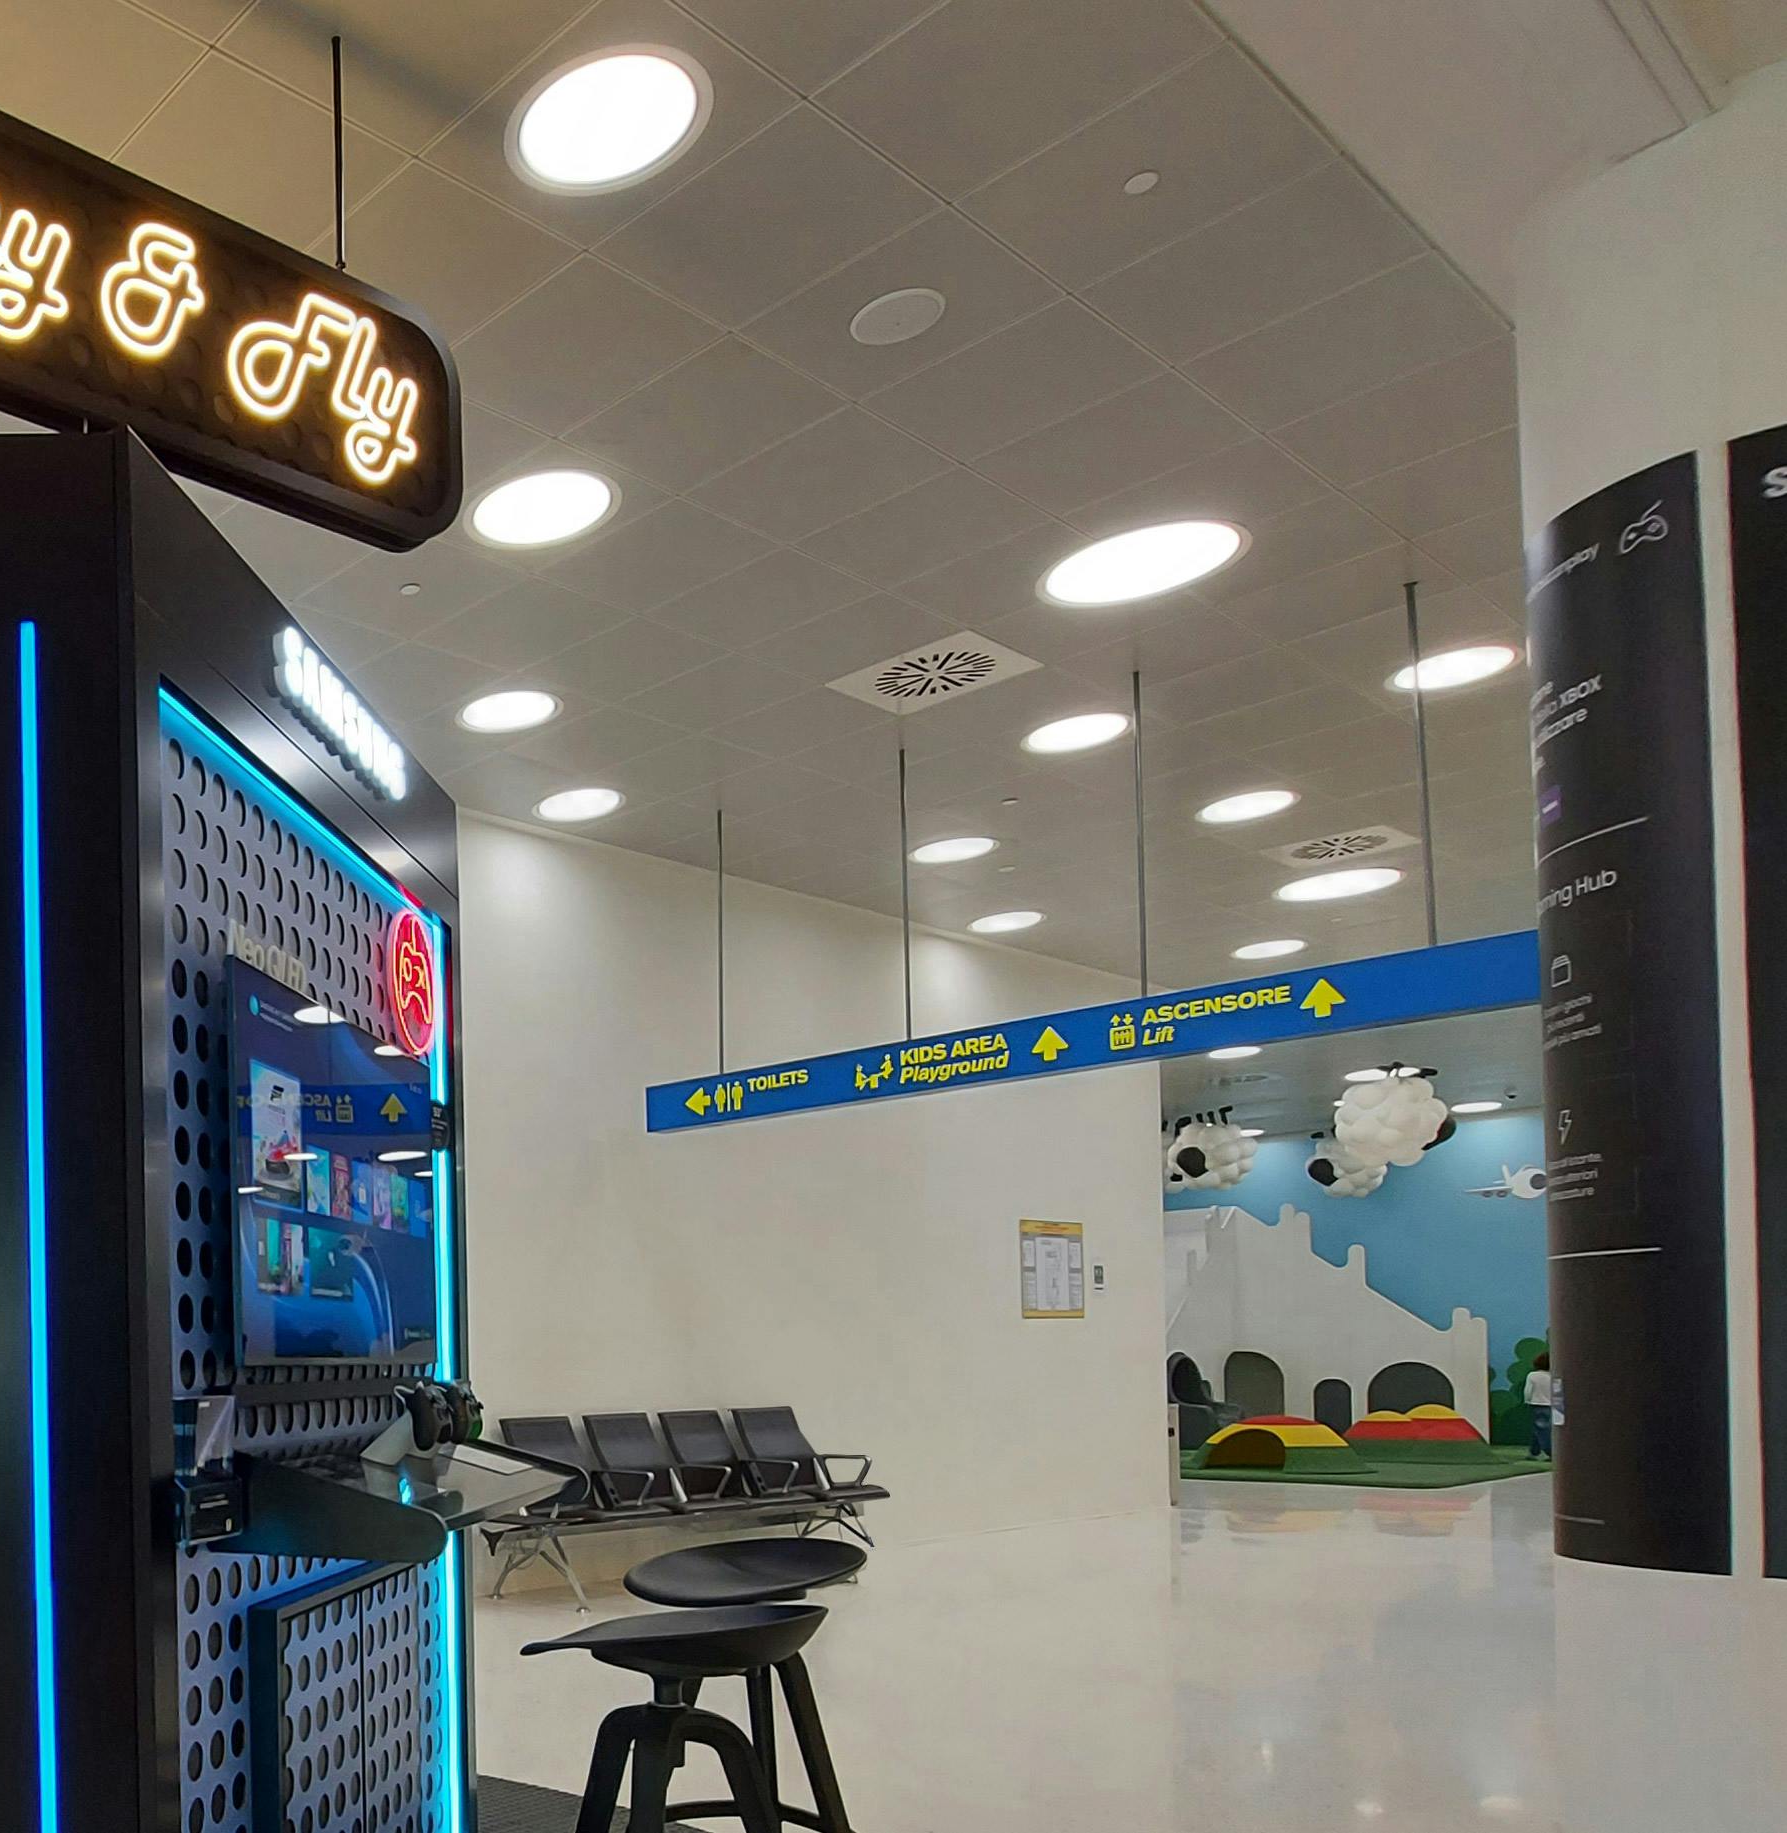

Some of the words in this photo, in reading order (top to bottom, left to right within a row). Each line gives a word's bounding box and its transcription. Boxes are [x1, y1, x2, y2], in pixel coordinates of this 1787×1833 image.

[100, 221, 206, 358] &
[227, 291, 420, 486] Fly
[276, 626, 408, 802] SAMSUNG
[1575, 869, 1617, 896] Hub
[227, 918, 265, 973] Neo
[1141, 985, 1292, 1026] ASCENSORE
[899, 1042, 948, 1067] KIDS
[950, 1032, 1008, 1058] AREA
[1142, 1025, 1175, 1046] Lift
[747, 1068, 809, 1093] TOILETS
[899, 1049, 1010, 1084] Playground
